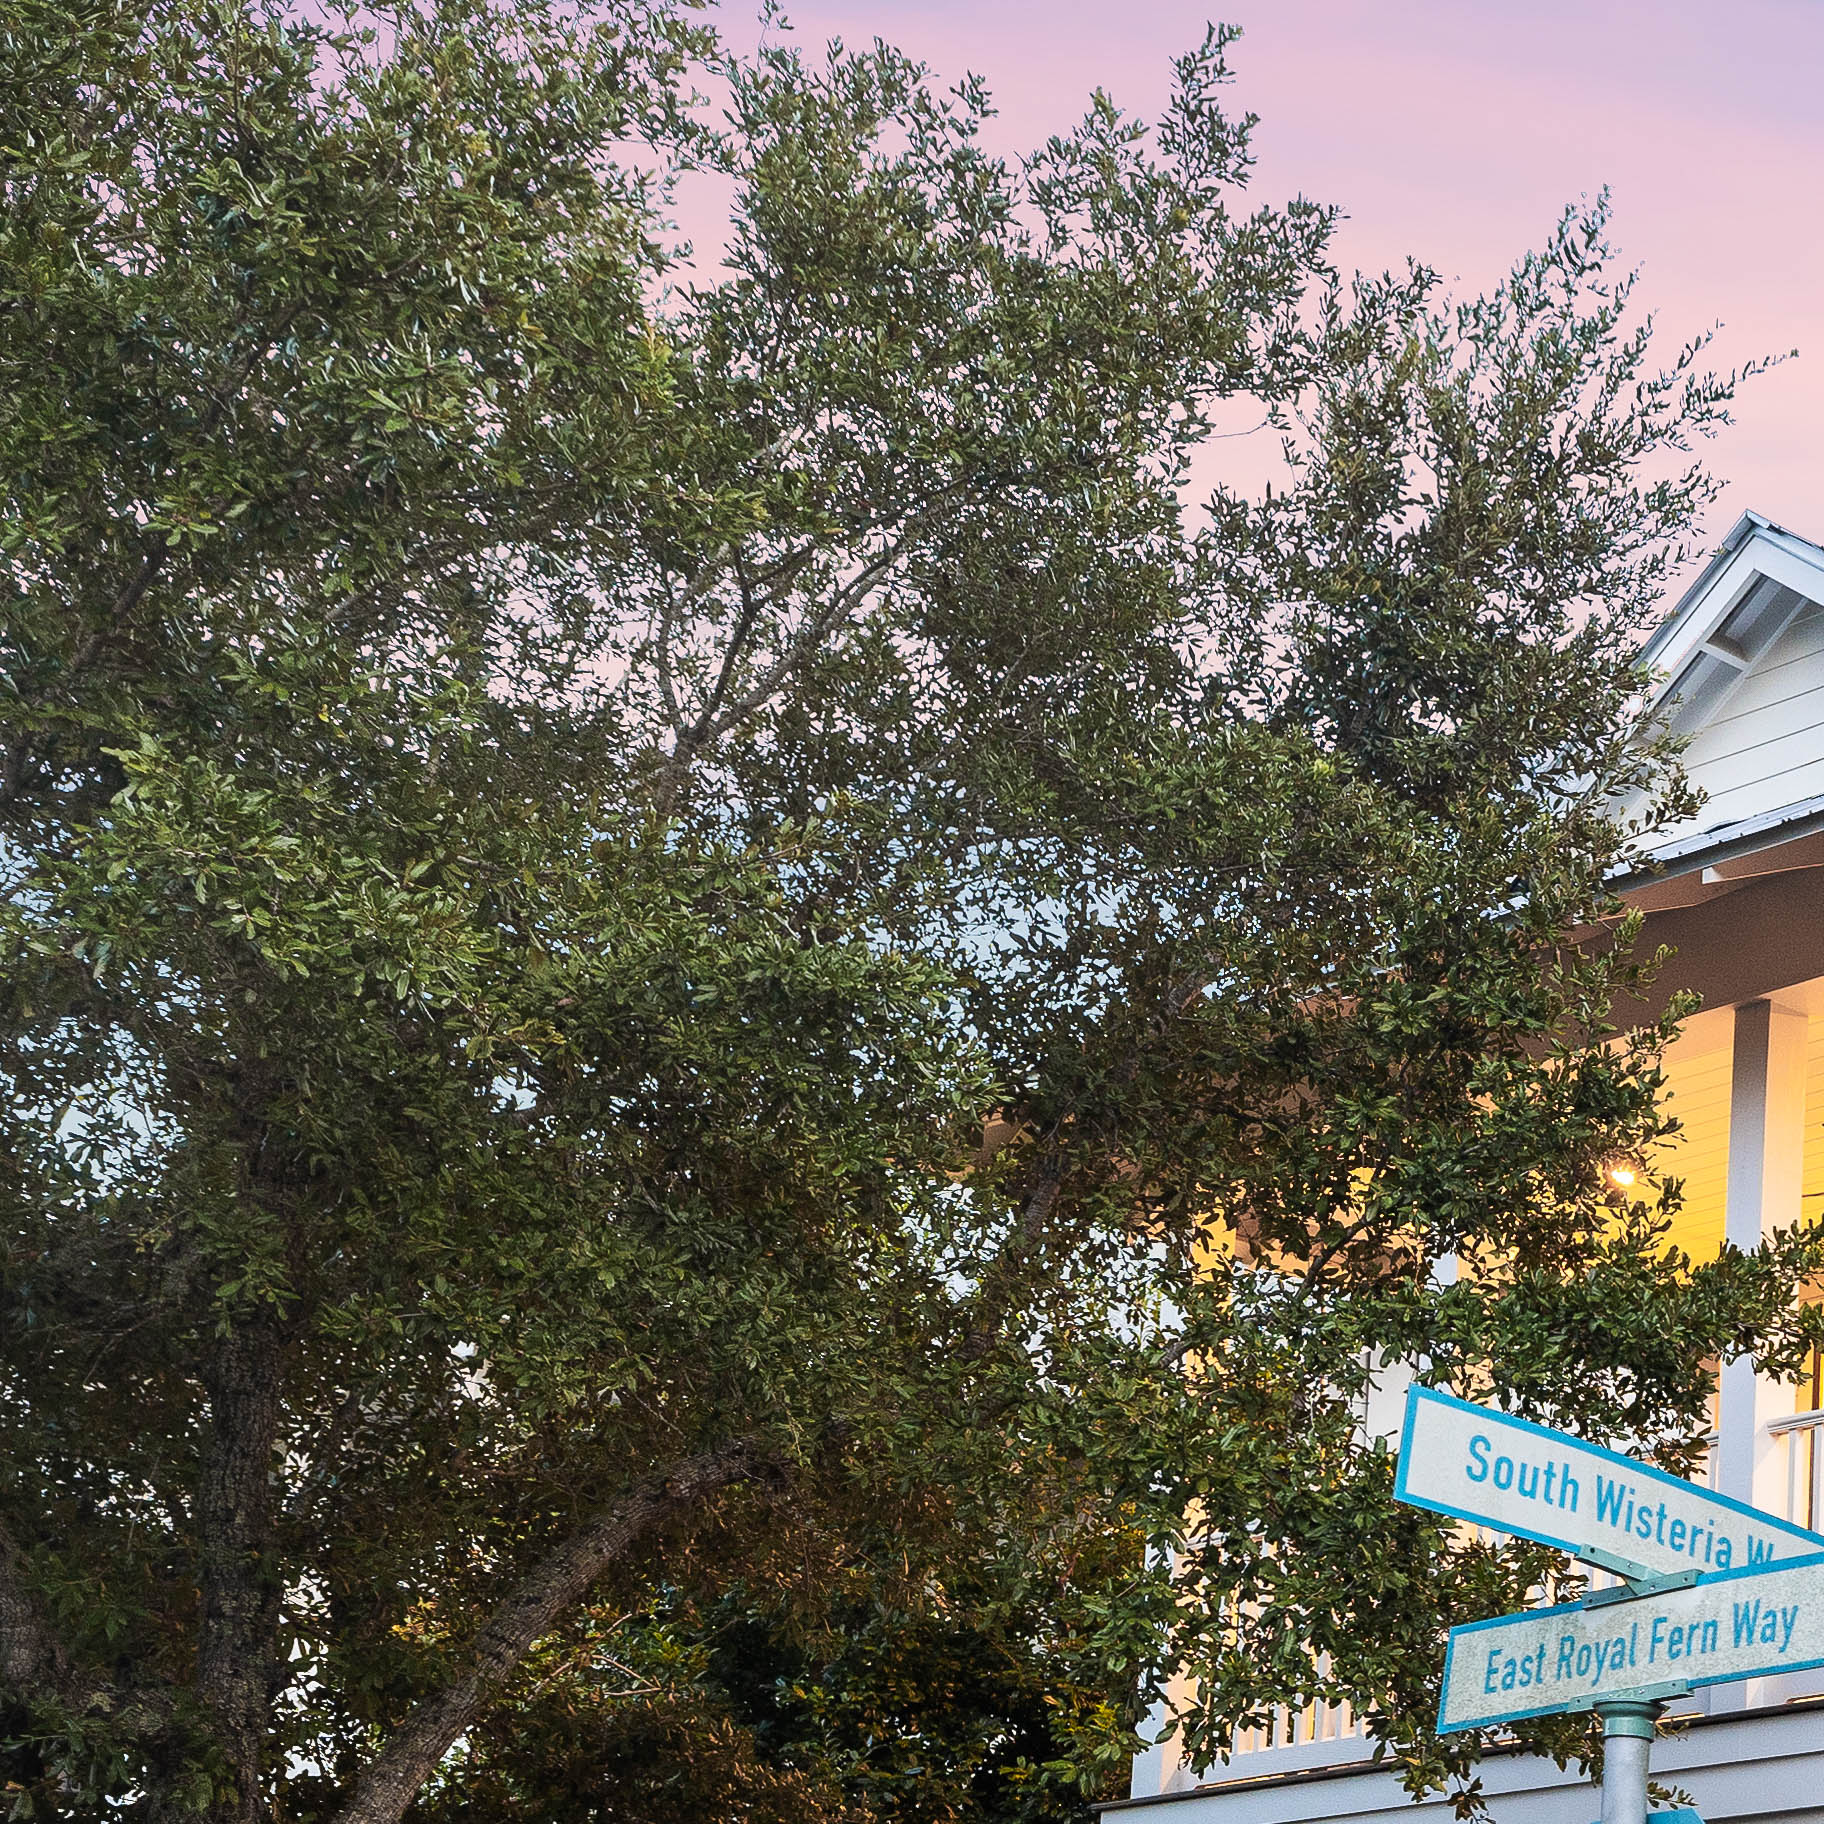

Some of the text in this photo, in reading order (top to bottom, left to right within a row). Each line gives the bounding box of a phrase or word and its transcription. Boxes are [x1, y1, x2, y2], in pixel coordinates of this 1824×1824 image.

[1466, 1434, 1579, 1513] South
[1596, 1474, 1732, 1569] Wisteria
[1484, 1599, 1799, 1694] East Royal Fern Way
